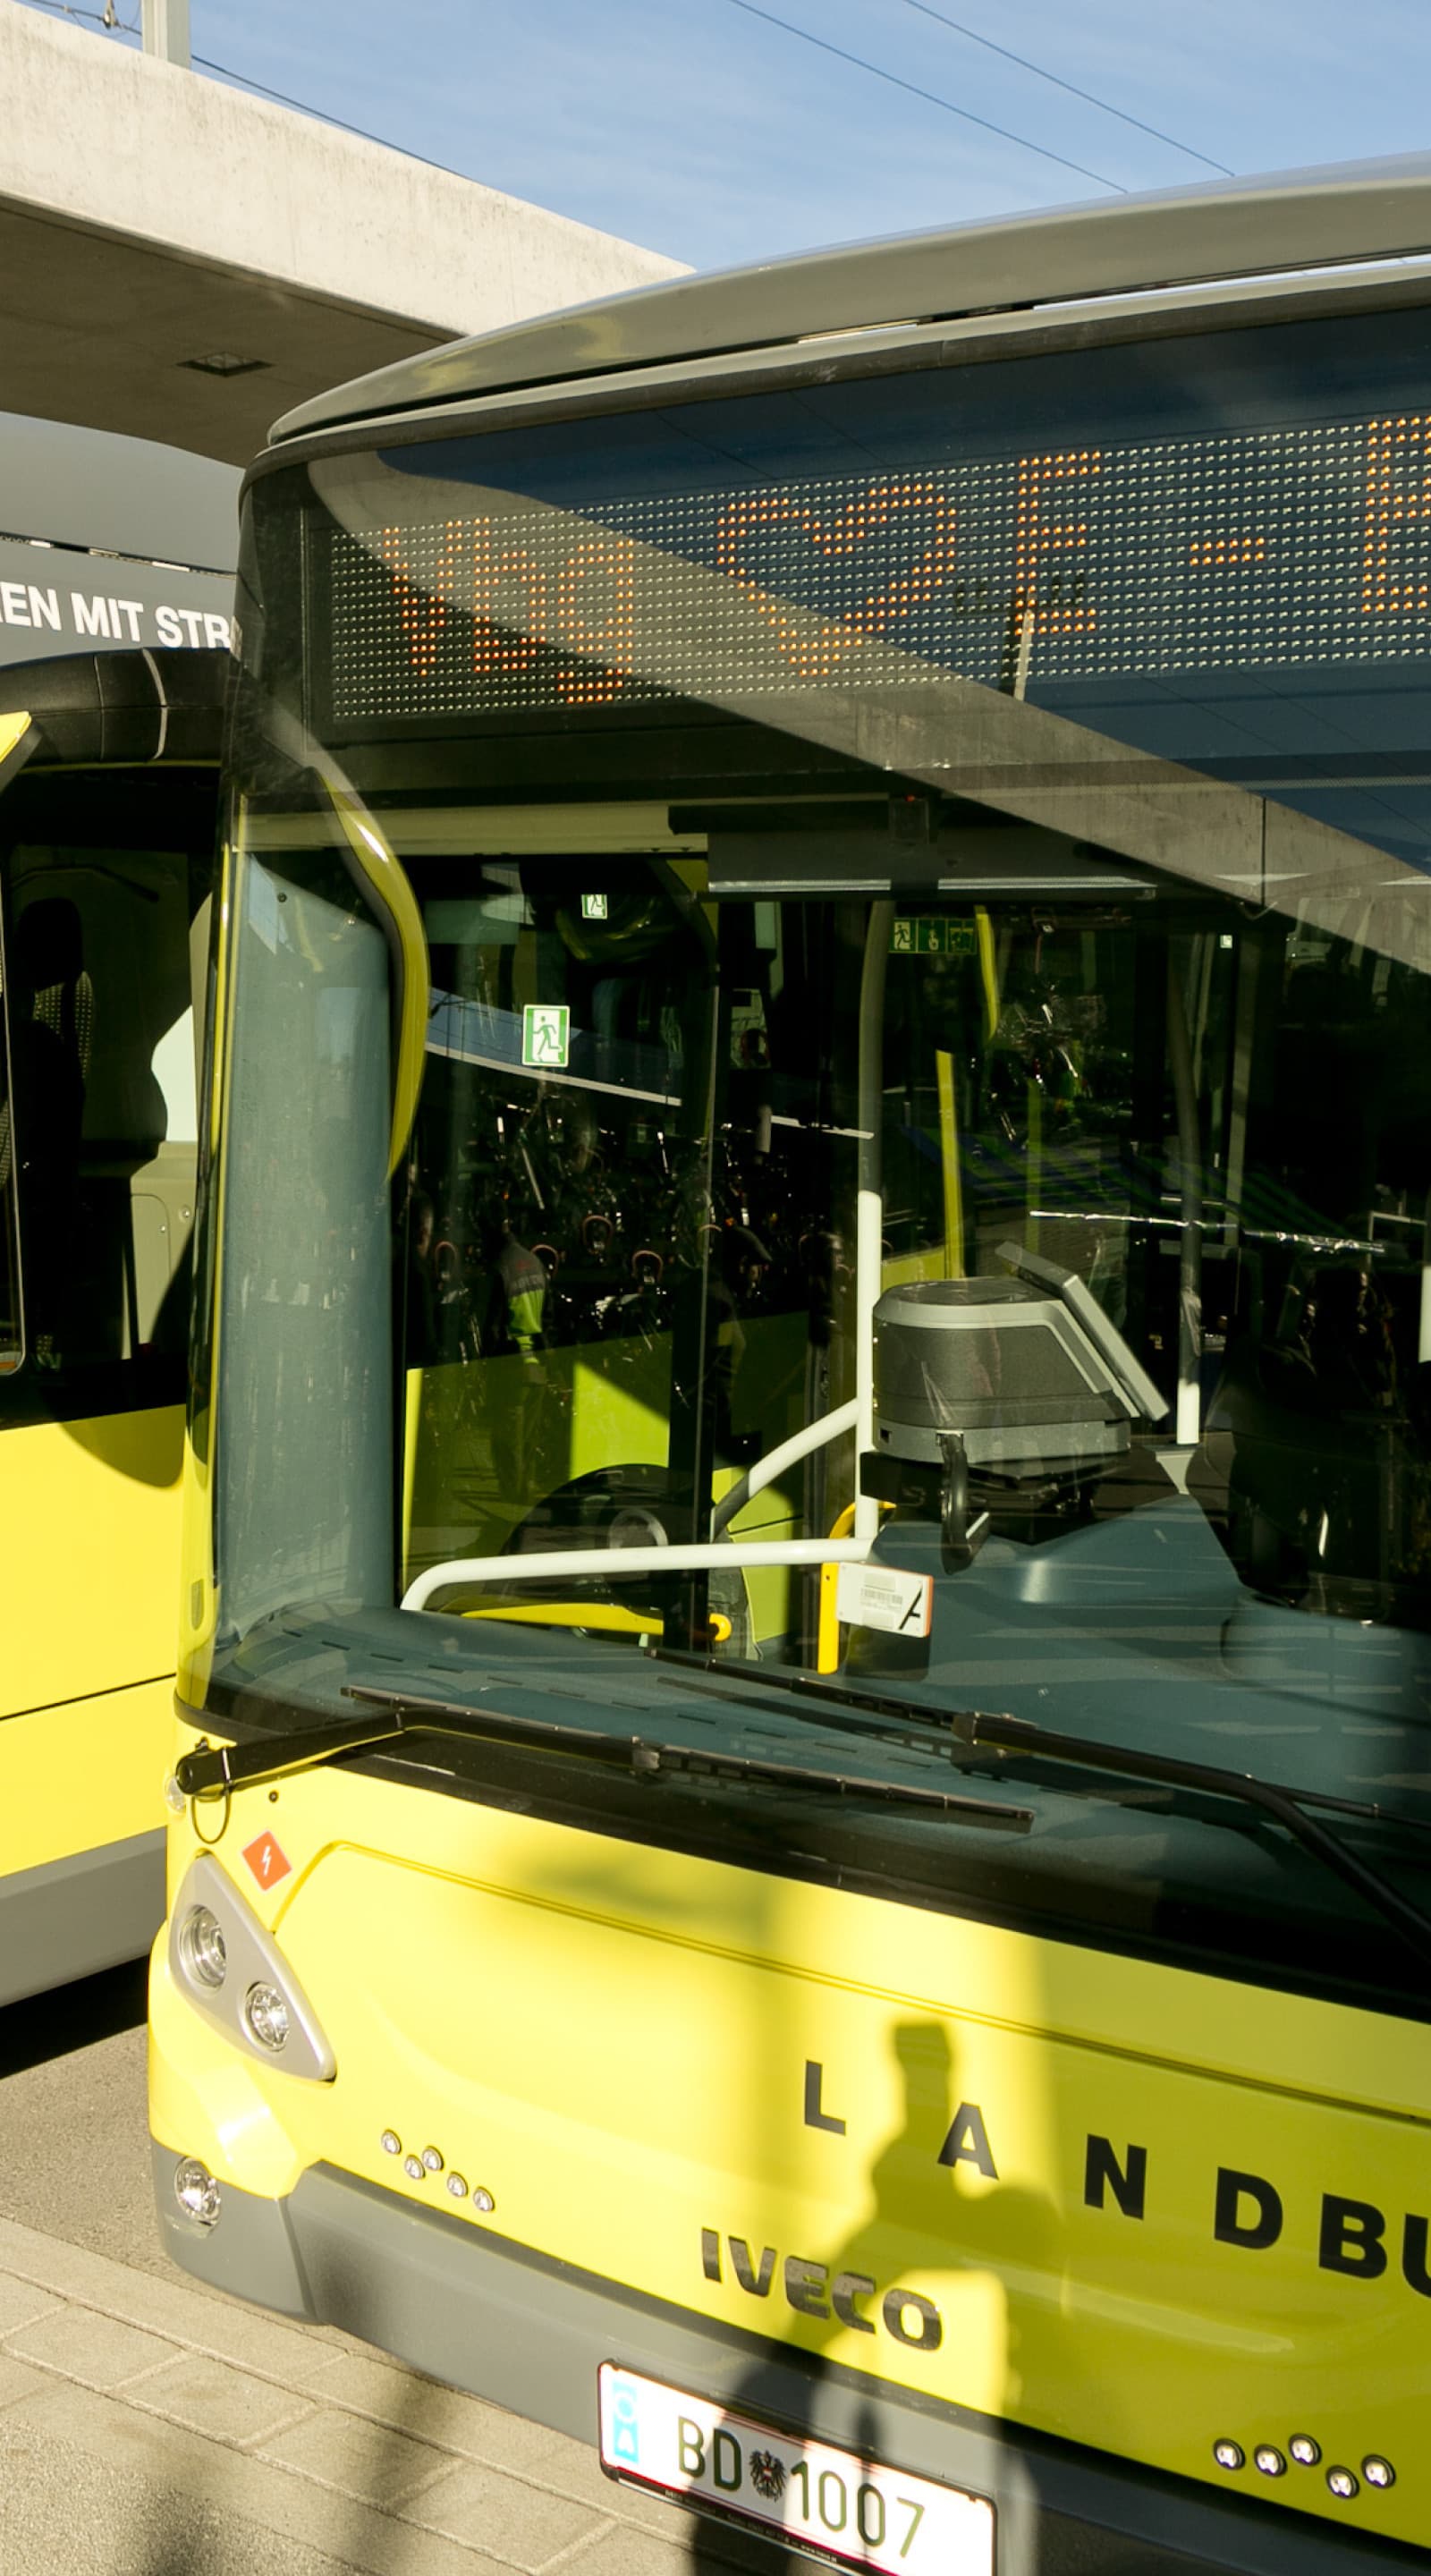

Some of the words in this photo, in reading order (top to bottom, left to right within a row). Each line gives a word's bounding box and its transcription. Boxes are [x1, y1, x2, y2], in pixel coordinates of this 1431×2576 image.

[0, 581, 62, 631] EN
[71, 591, 144, 643] MIT
[384, 517, 635, 702] Vbg
[1015, 450, 1101, 634] E
[701, 2227, 944, 2351] IVECO
[678, 2415, 742, 2492] BD
[791, 2460, 926, 2558] 1007
